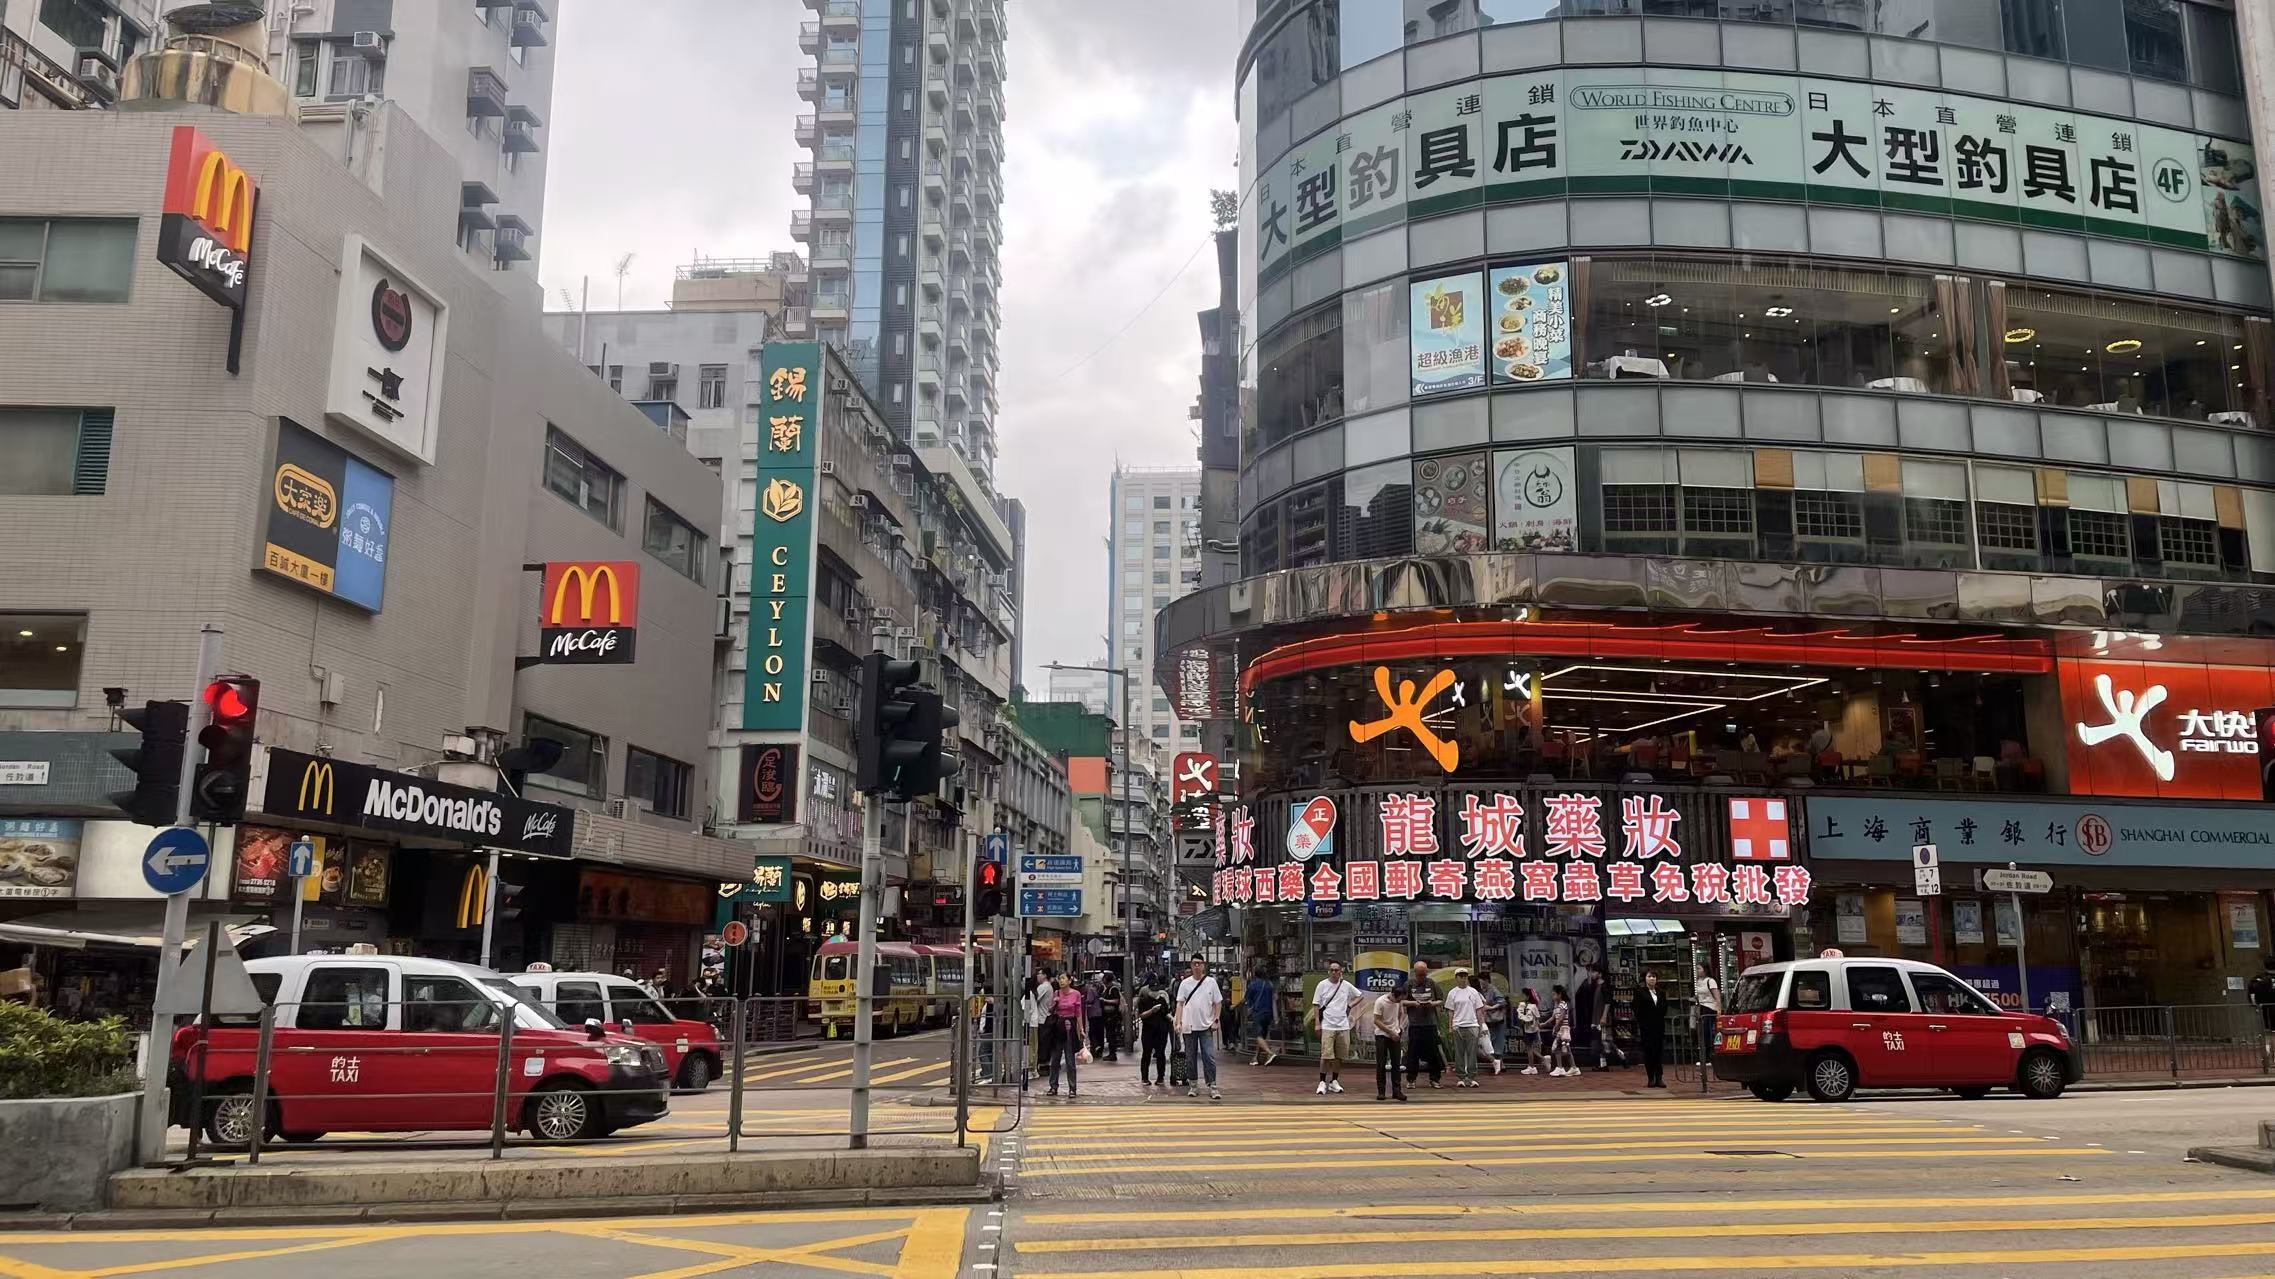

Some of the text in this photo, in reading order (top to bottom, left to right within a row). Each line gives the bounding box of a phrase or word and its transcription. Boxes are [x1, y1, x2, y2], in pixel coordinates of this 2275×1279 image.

[1635, 115, 1739, 134] 世界釣魚中心
[1808, 91, 2134, 153] 日本直營連鎖
[1261, 84, 1555, 205] 日本直營連鎖
[1812, 119, 2139, 214] 大型釣具店
[1261, 113, 1557, 262] 大型釣具店
[2156, 167, 2184, 195] 4F
[189, 237, 244, 289] McCafé
[1417, 344, 1480, 369] 超級漁港
[1467, 375, 1484, 386] 3/F
[769, 367, 806, 453] 錫蘭
[762, 546, 788, 703] CEYLON
[550, 630, 618, 657] McCafé
[364, 779, 502, 836] McDonald's
[1311, 807, 1329, 823] 正
[1380, 793, 1681, 859] 龍城藥妝
[1817, 815, 2067, 847] 上海商業銀行
[2120, 828, 2273, 845] SHANGHAI COMMERCIAL
[1929, 869, 1934, 878] 7
[1931, 883, 1939, 893] 12
[1520, 953, 1558, 967] NAN
[1367, 976, 1396, 987] Friso
[1883, 1031, 1903, 1041] 的士
[1884, 1040, 1905, 1051] TAXI
[331, 1056, 360, 1069] 的士
[330, 1069, 359, 1083] TAXI
